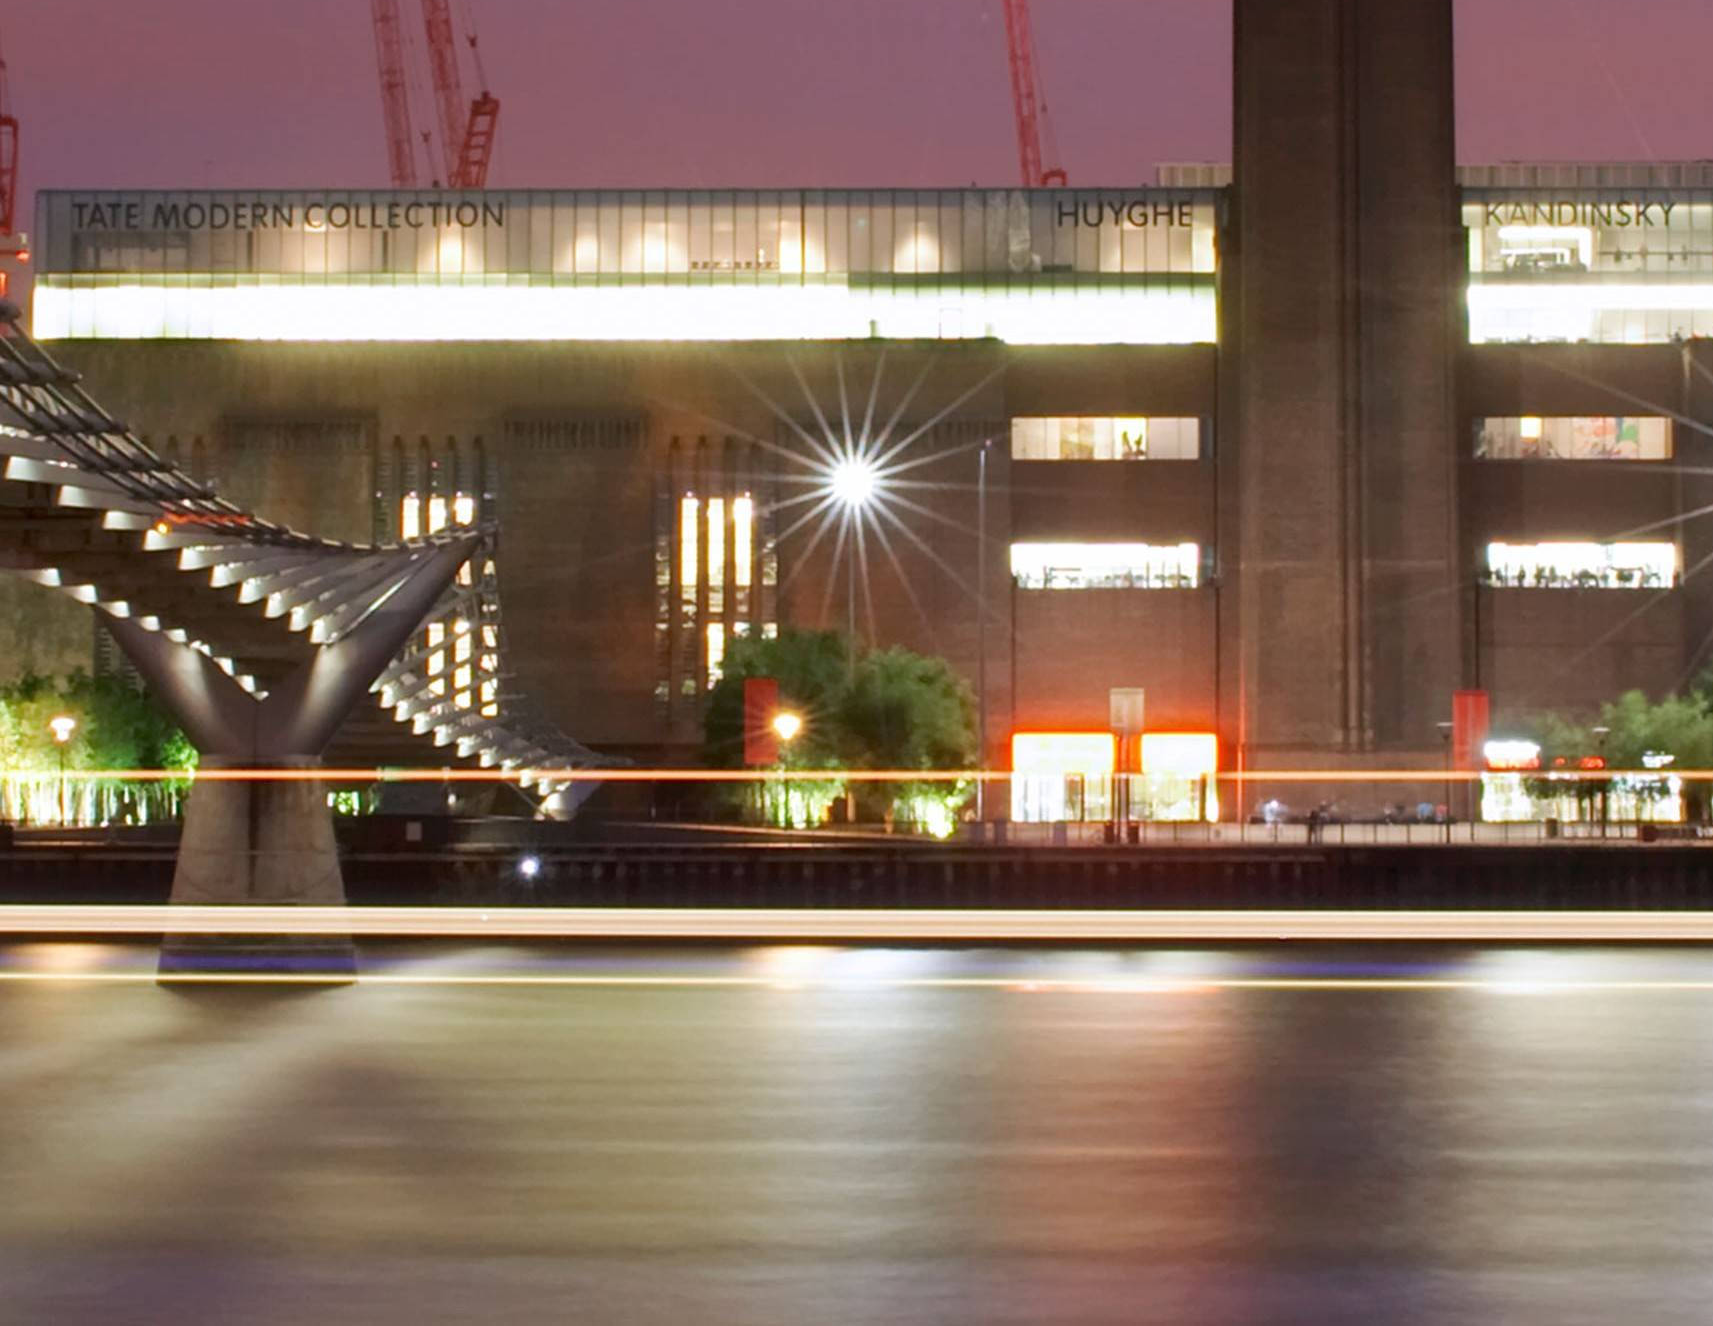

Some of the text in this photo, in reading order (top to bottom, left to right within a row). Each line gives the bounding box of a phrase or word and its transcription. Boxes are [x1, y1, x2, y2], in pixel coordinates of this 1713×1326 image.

[73, 202, 505, 229] TATE MODERN COLLECTION
[1057, 201, 1193, 227] HUYGHE
[1485, 201, 1676, 227] KANDINSKY
